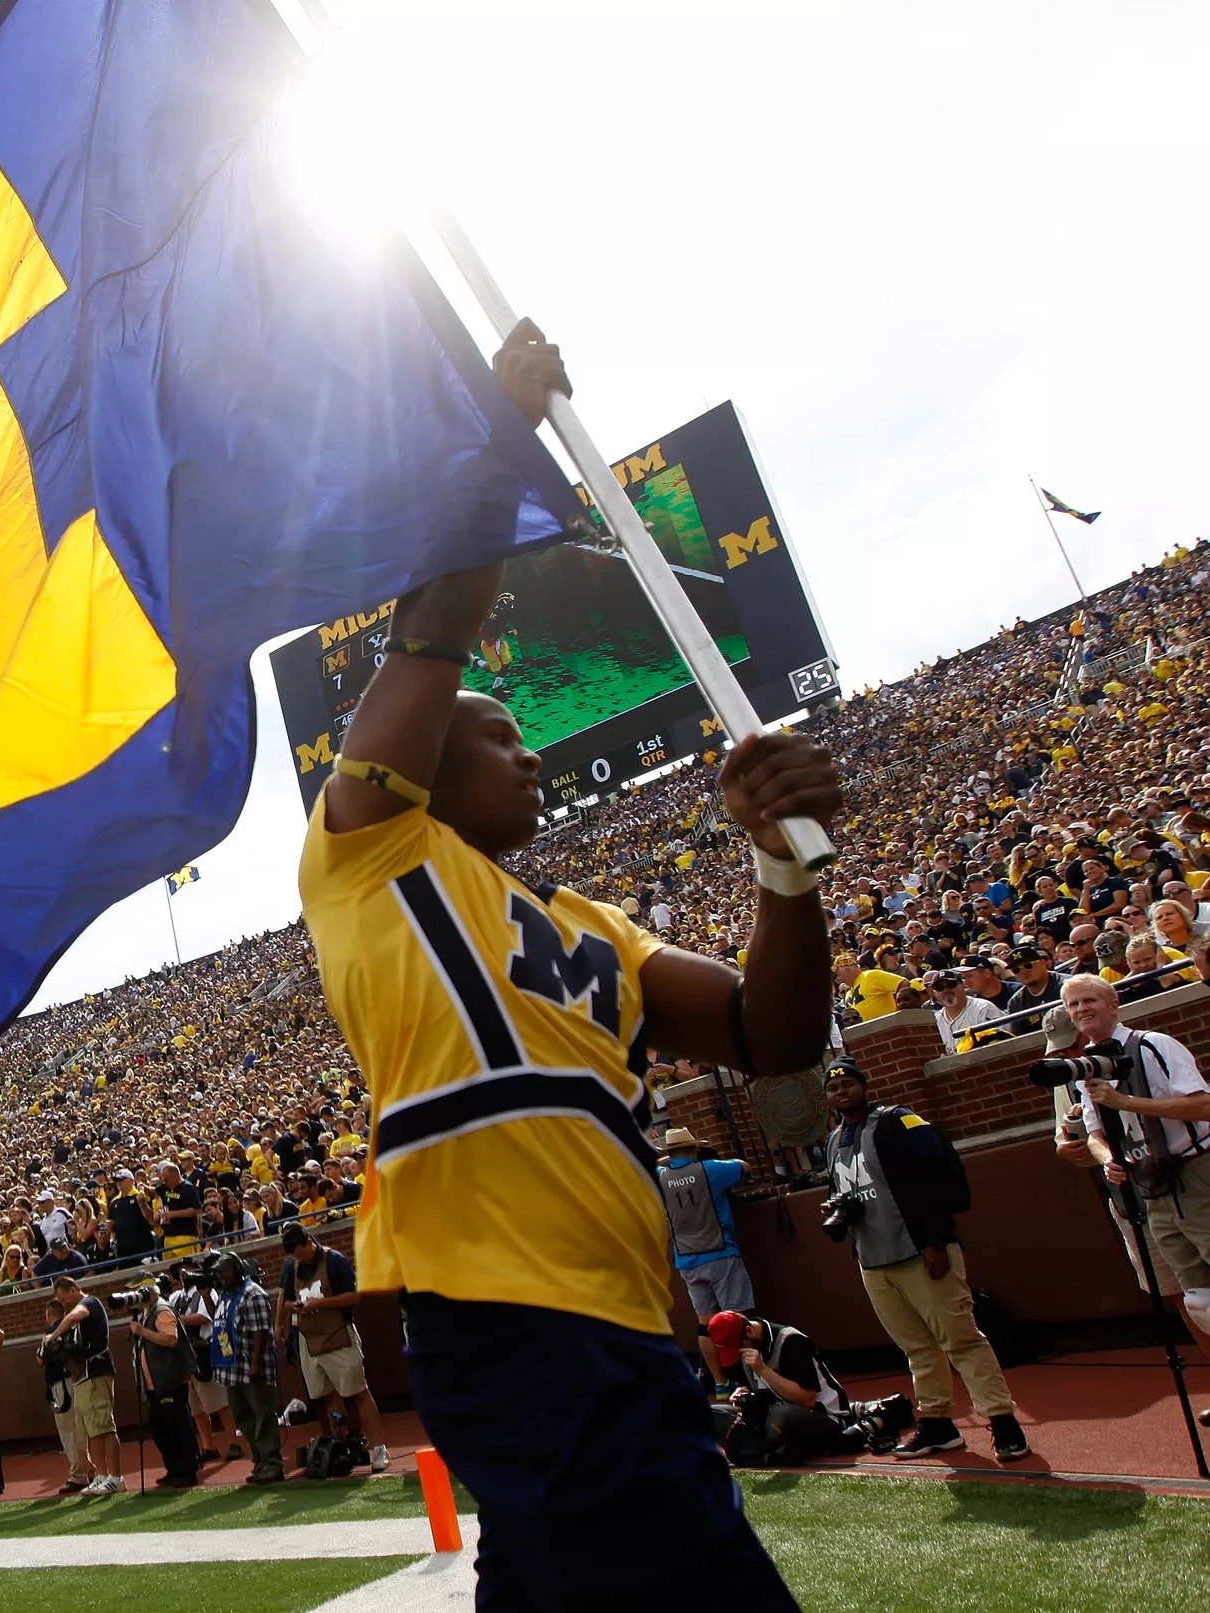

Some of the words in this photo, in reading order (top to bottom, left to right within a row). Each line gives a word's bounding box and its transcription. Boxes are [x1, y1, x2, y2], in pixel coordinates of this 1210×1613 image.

[718, 515, 778, 570] M
[368, 633, 382, 648] Y
[325, 649, 348, 674] M
[373, 653, 385, 669] 0
[333, 673, 343, 690] 7
[797, 664, 833, 696] 25
[699, 714, 725, 738] M
[295, 732, 335, 774] M
[636, 734, 664, 756] 1st
[640, 749, 666, 767] QTR
[550, 770, 580, 789] BALL
[591, 758, 611, 783] 0
[560, 785, 578, 799] ON
[504, 887, 623, 1044] M
[829, 1067, 846, 1078] M
[667, 1175, 696, 1188] PHOTO
[834, 1152, 873, 1194] M
[674, 1187, 696, 1209] 11
